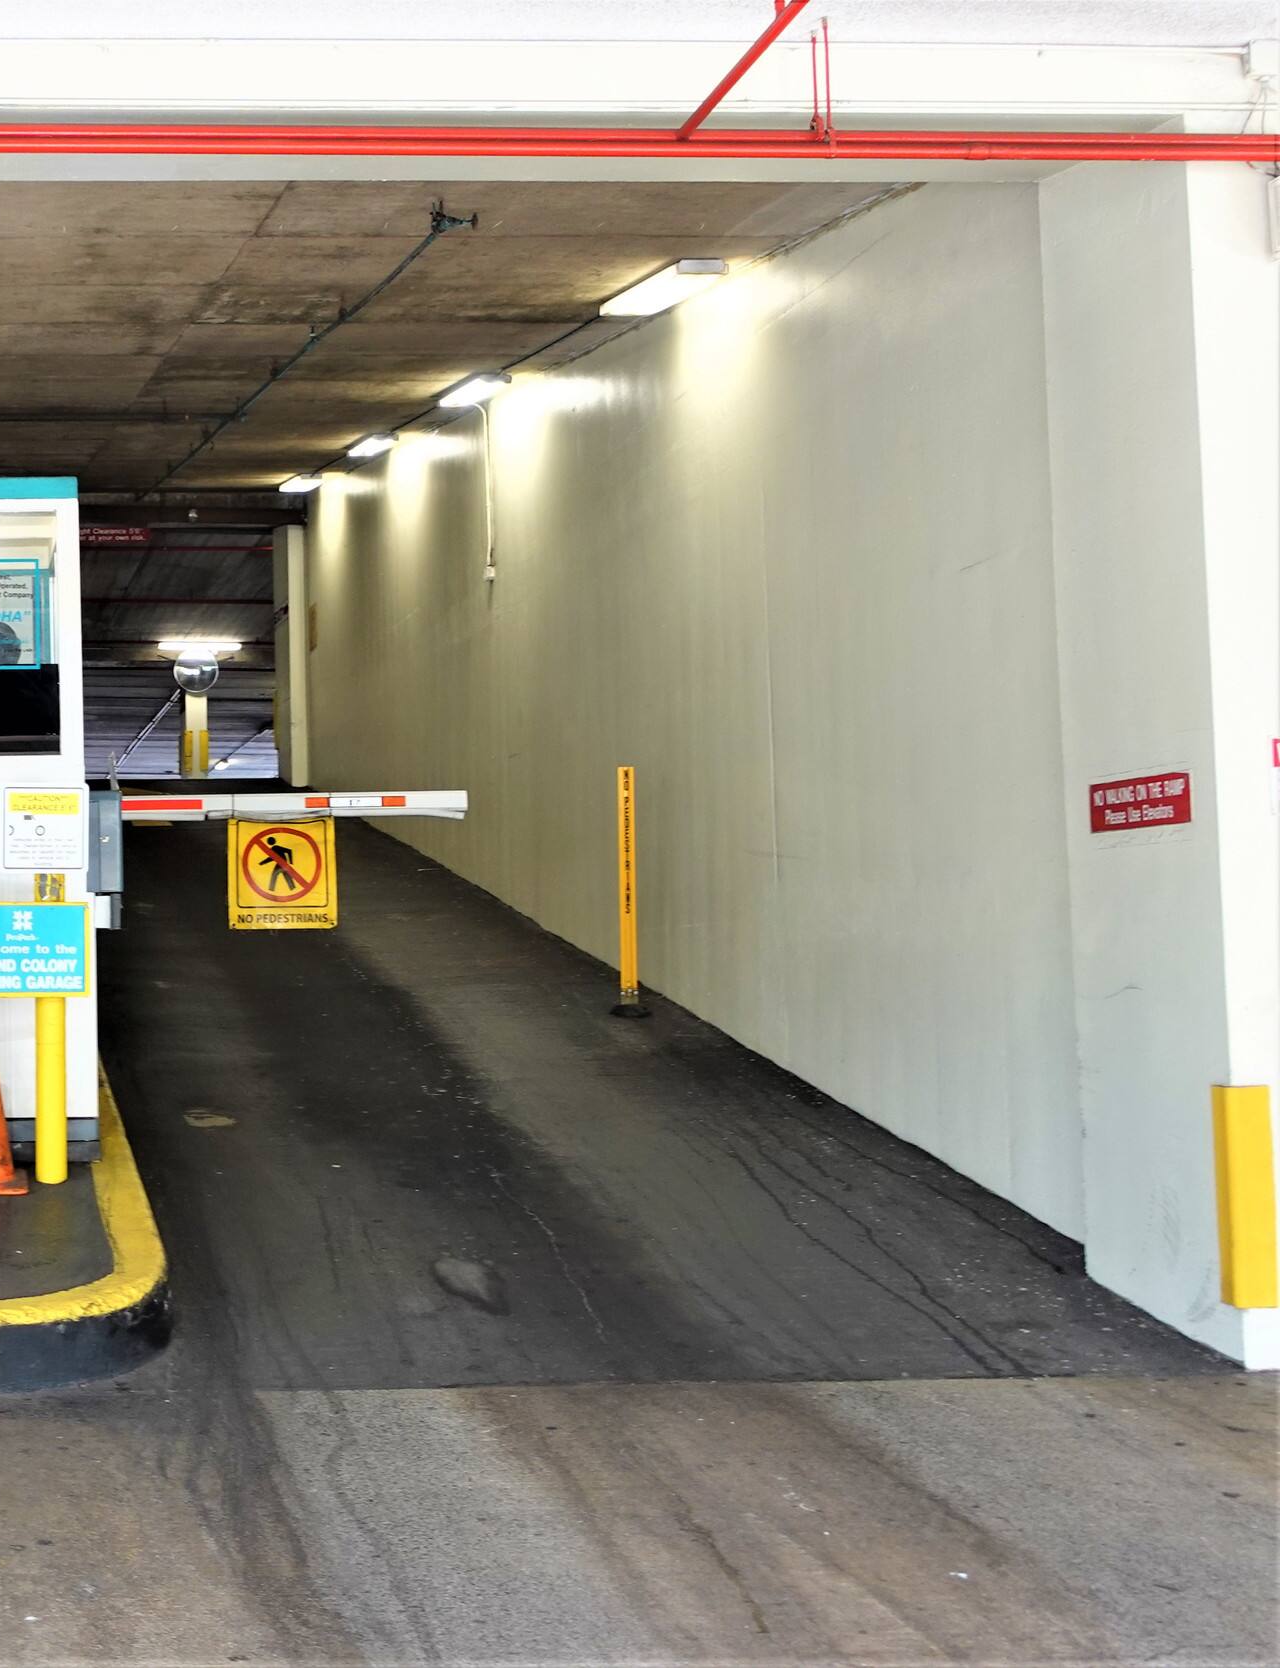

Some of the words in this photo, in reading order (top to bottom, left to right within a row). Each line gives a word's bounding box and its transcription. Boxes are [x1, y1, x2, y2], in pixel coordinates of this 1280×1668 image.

[3, 591, 34, 600] Company
[1093, 790, 1104, 806] NO
[1105, 786, 1135, 805] WALKING
[1136, 784, 1147, 801] ON
[1148, 781, 1163, 799] THE
[1163, 778, 1185, 797] RAMP
[1105, 809, 1127, 825] Please
[1127, 807, 1141, 823] Use
[1142, 803, 1174, 821] Elevators
[237, 913, 253, 924] NO
[256, 913, 329, 924] PEDESTRIANS
[36, 944, 50, 954] to
[55, 944, 77, 955] the
[20, 958, 78, 973] COLONY
[25, 975, 83, 990] GARAGE
